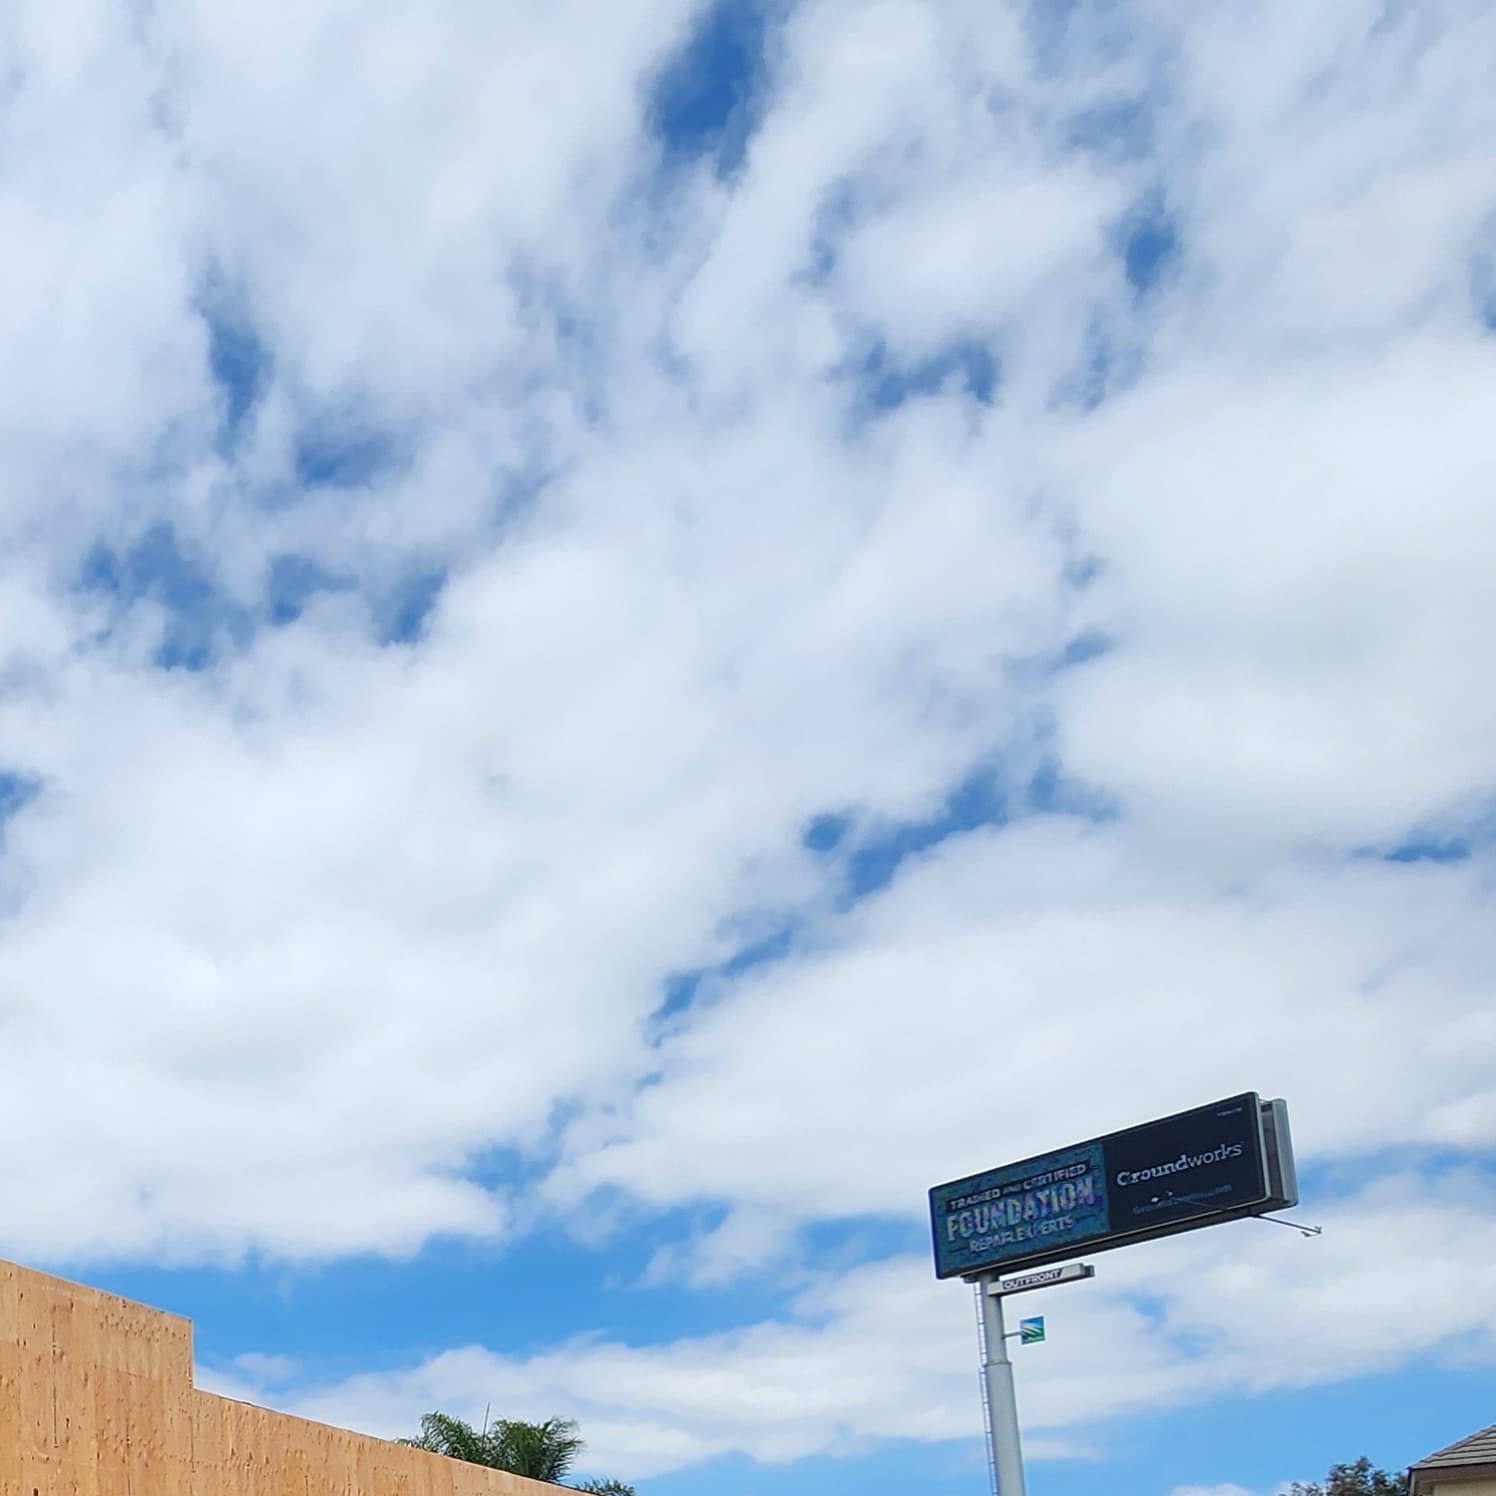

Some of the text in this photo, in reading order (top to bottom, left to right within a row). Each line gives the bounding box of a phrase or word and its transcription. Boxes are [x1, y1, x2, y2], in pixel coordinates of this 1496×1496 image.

[1023, 1164, 1087, 1190] CERTIFIED
[1116, 1143, 1243, 1186] Groundworks
[947, 1176, 1097, 1242] FOUNDATION
[1004, 1269, 1061, 1289] OUTFRONT
